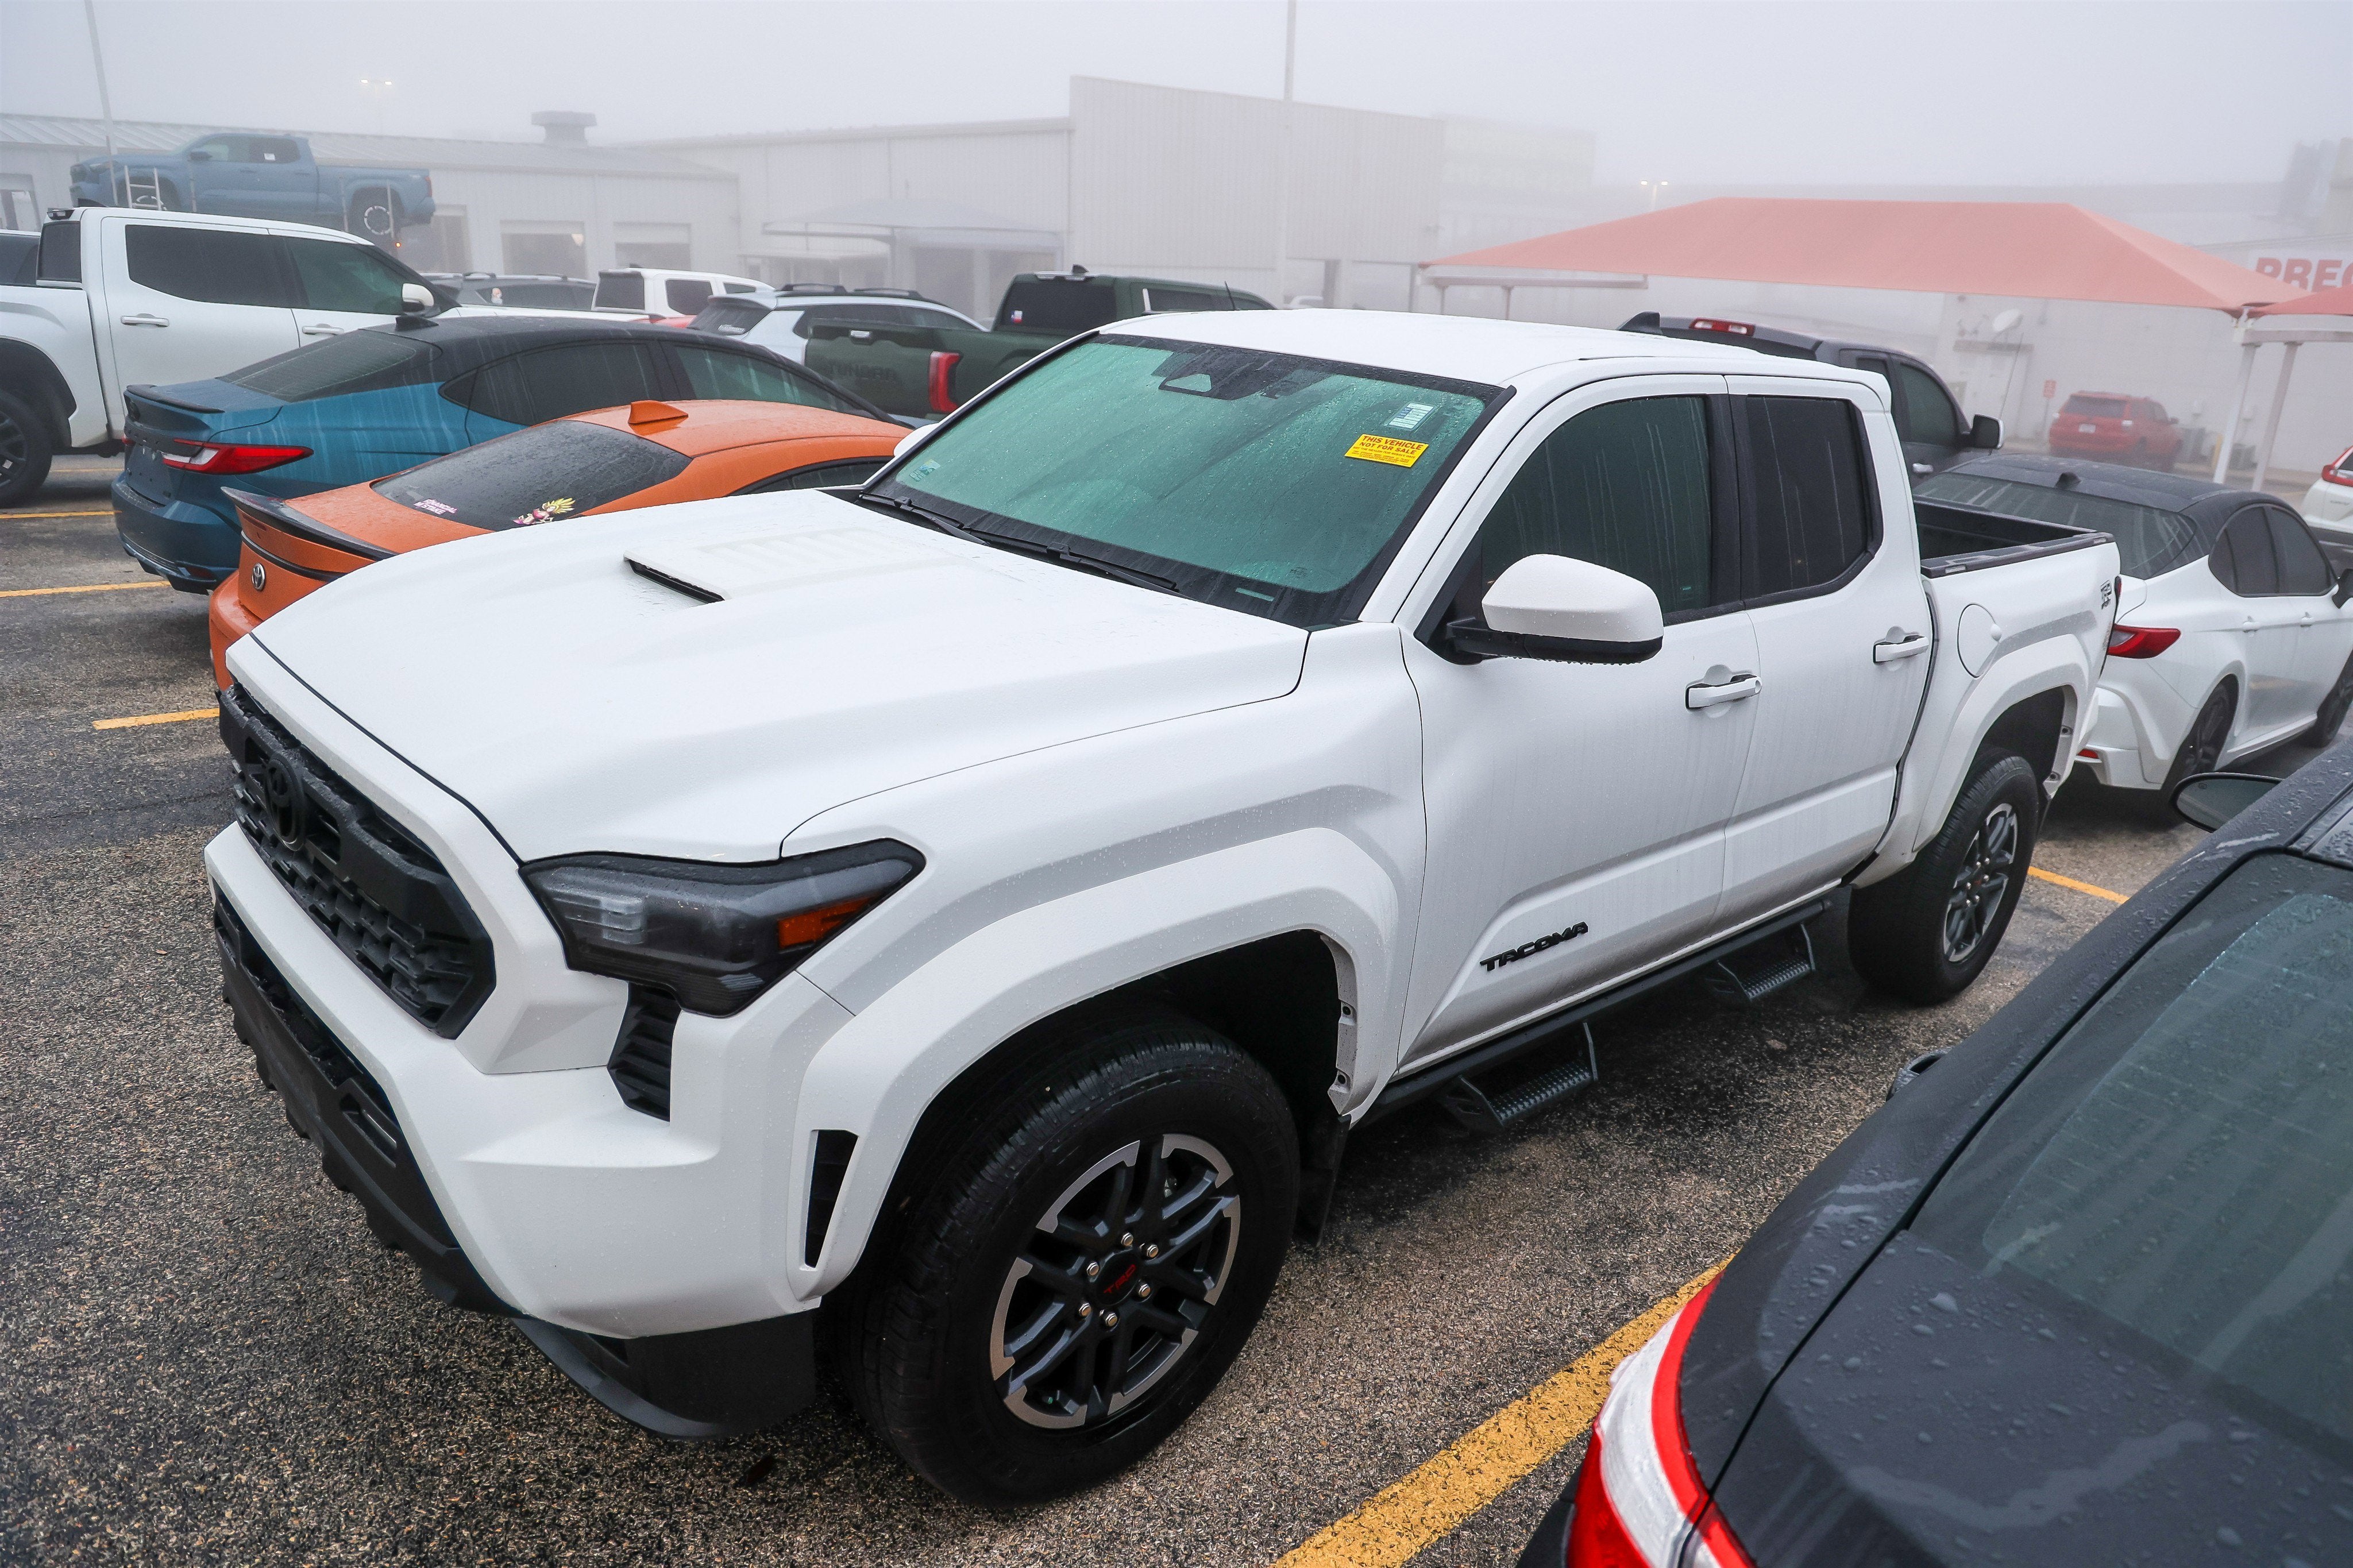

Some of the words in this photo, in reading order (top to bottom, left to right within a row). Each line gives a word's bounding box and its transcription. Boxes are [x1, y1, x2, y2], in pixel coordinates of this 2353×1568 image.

[1362, 435, 1383, 443] THIS
[1384, 439, 1424, 450] VEHICLE
[423, 499, 457, 513] FINANCIAL
[1479, 921, 1589, 972] TACOMA
[1103, 1264, 1136, 1294] TRD
